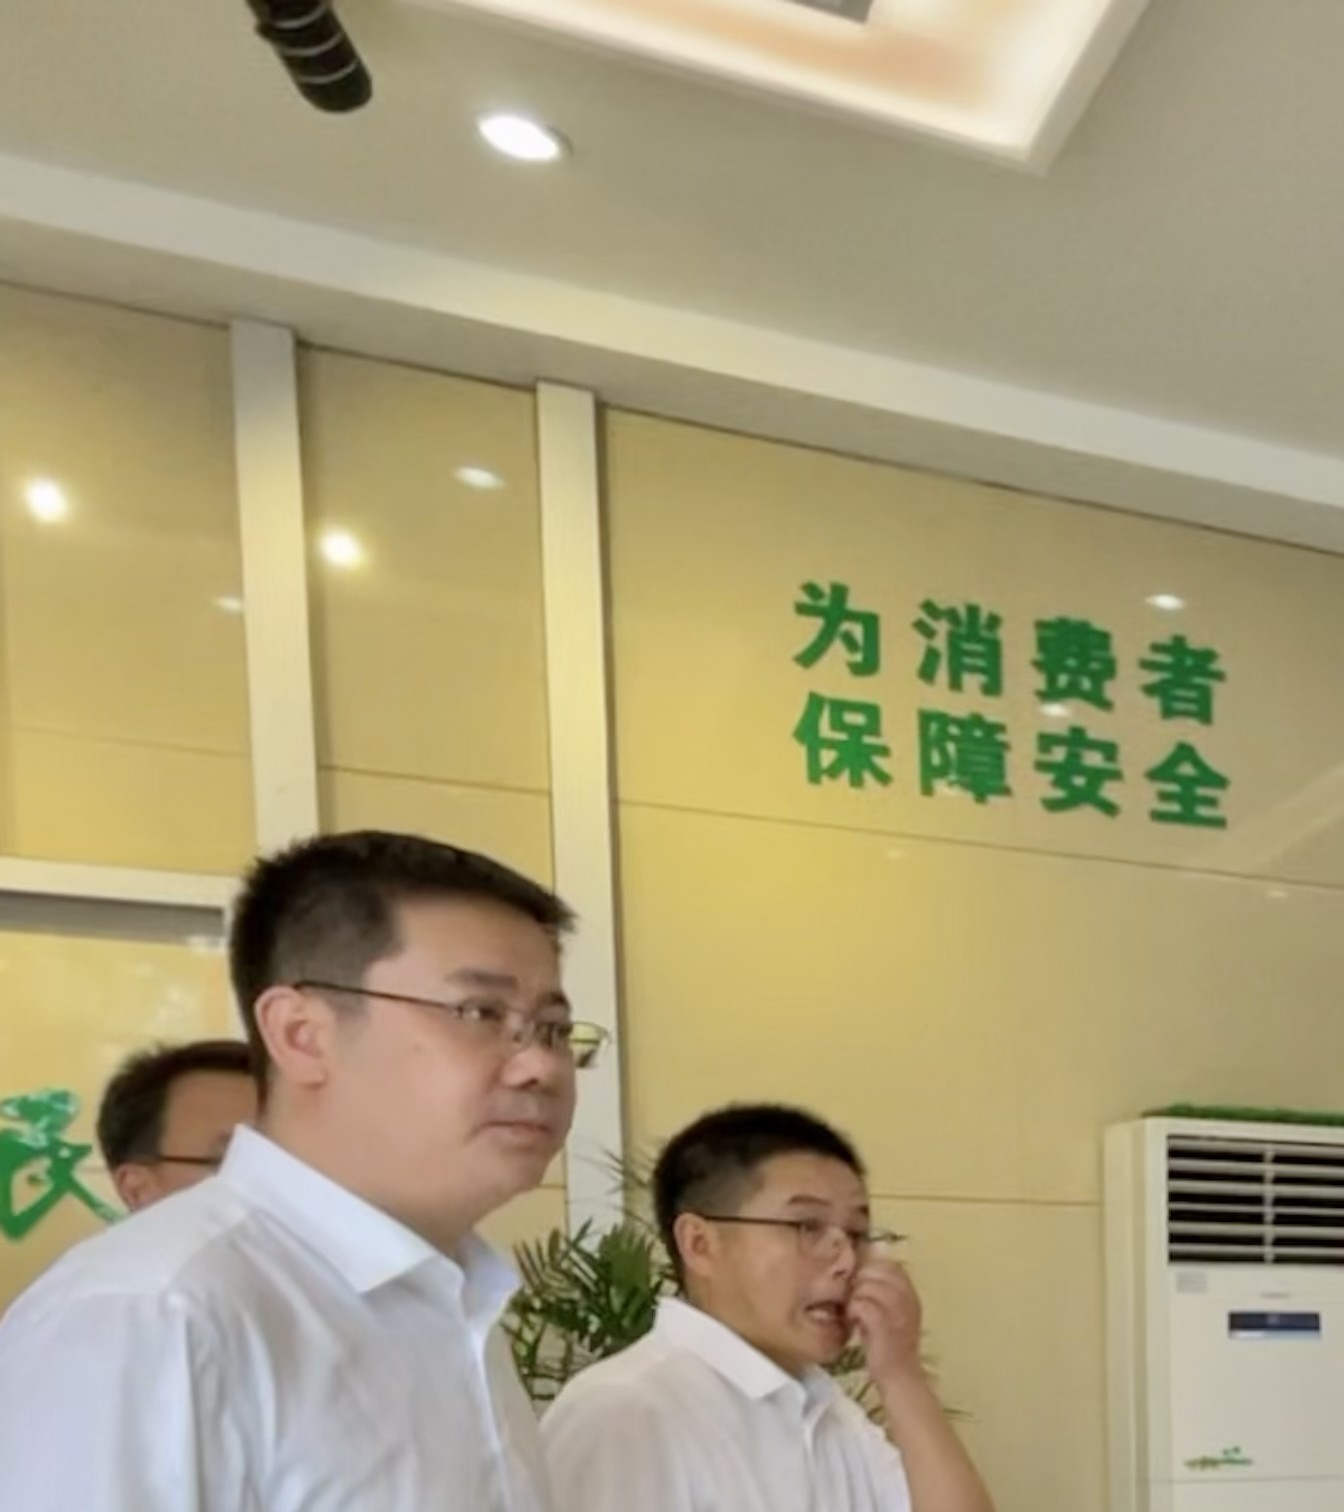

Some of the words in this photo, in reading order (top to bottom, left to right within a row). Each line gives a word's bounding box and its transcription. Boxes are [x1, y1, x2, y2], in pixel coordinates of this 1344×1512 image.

[792, 581, 1226, 726] 为消费者
[792, 691, 1230, 829] 保障安全
